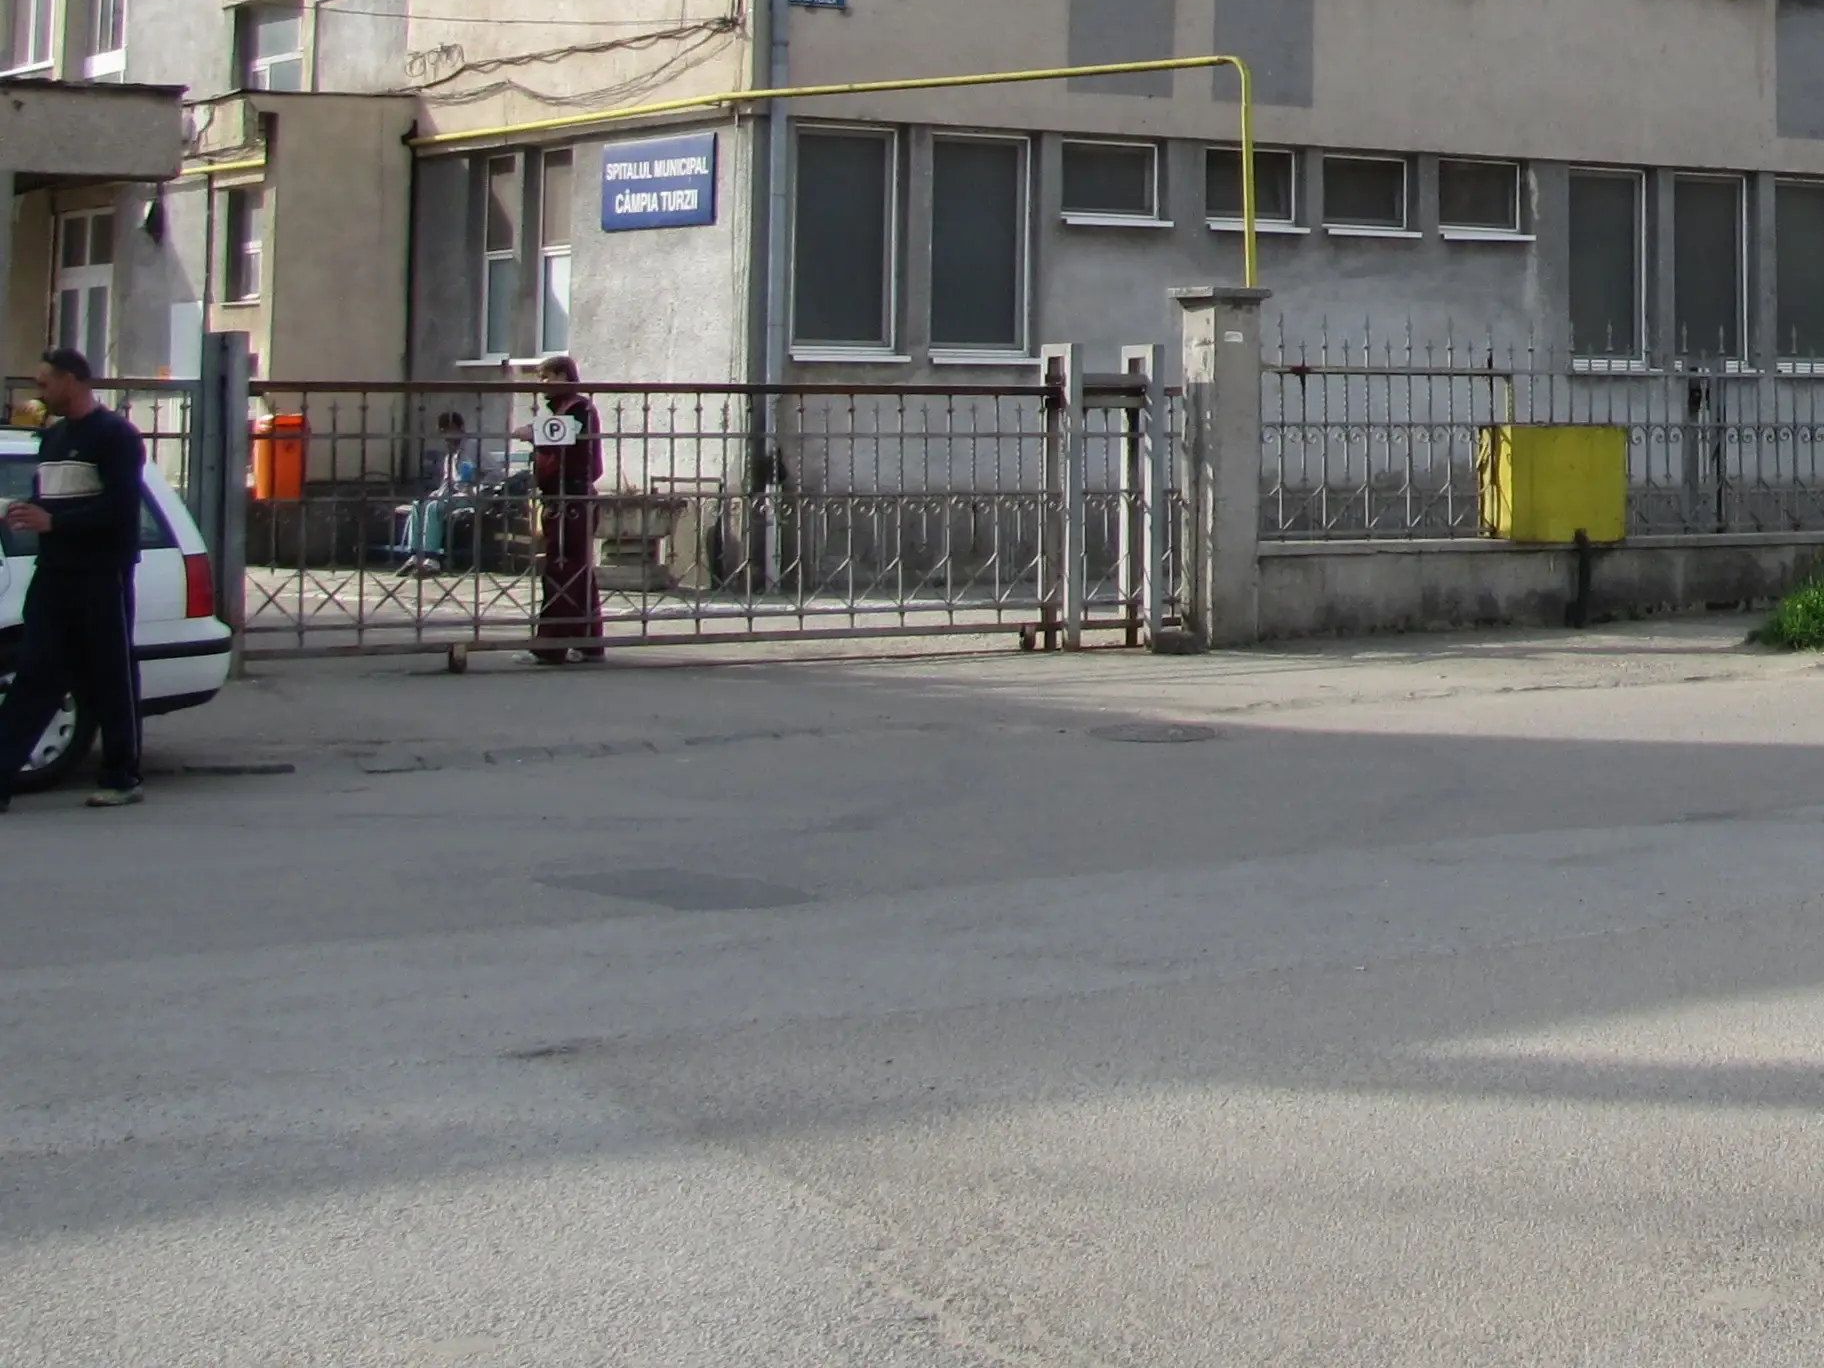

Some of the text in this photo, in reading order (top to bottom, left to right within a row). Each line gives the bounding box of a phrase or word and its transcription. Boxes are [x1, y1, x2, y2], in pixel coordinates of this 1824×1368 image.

[606, 156, 709, 181] SPITALUL MUNICIPAL
[615, 188, 698, 214] CÂMPIA TURZII
[550, 423, 560, 437] P
